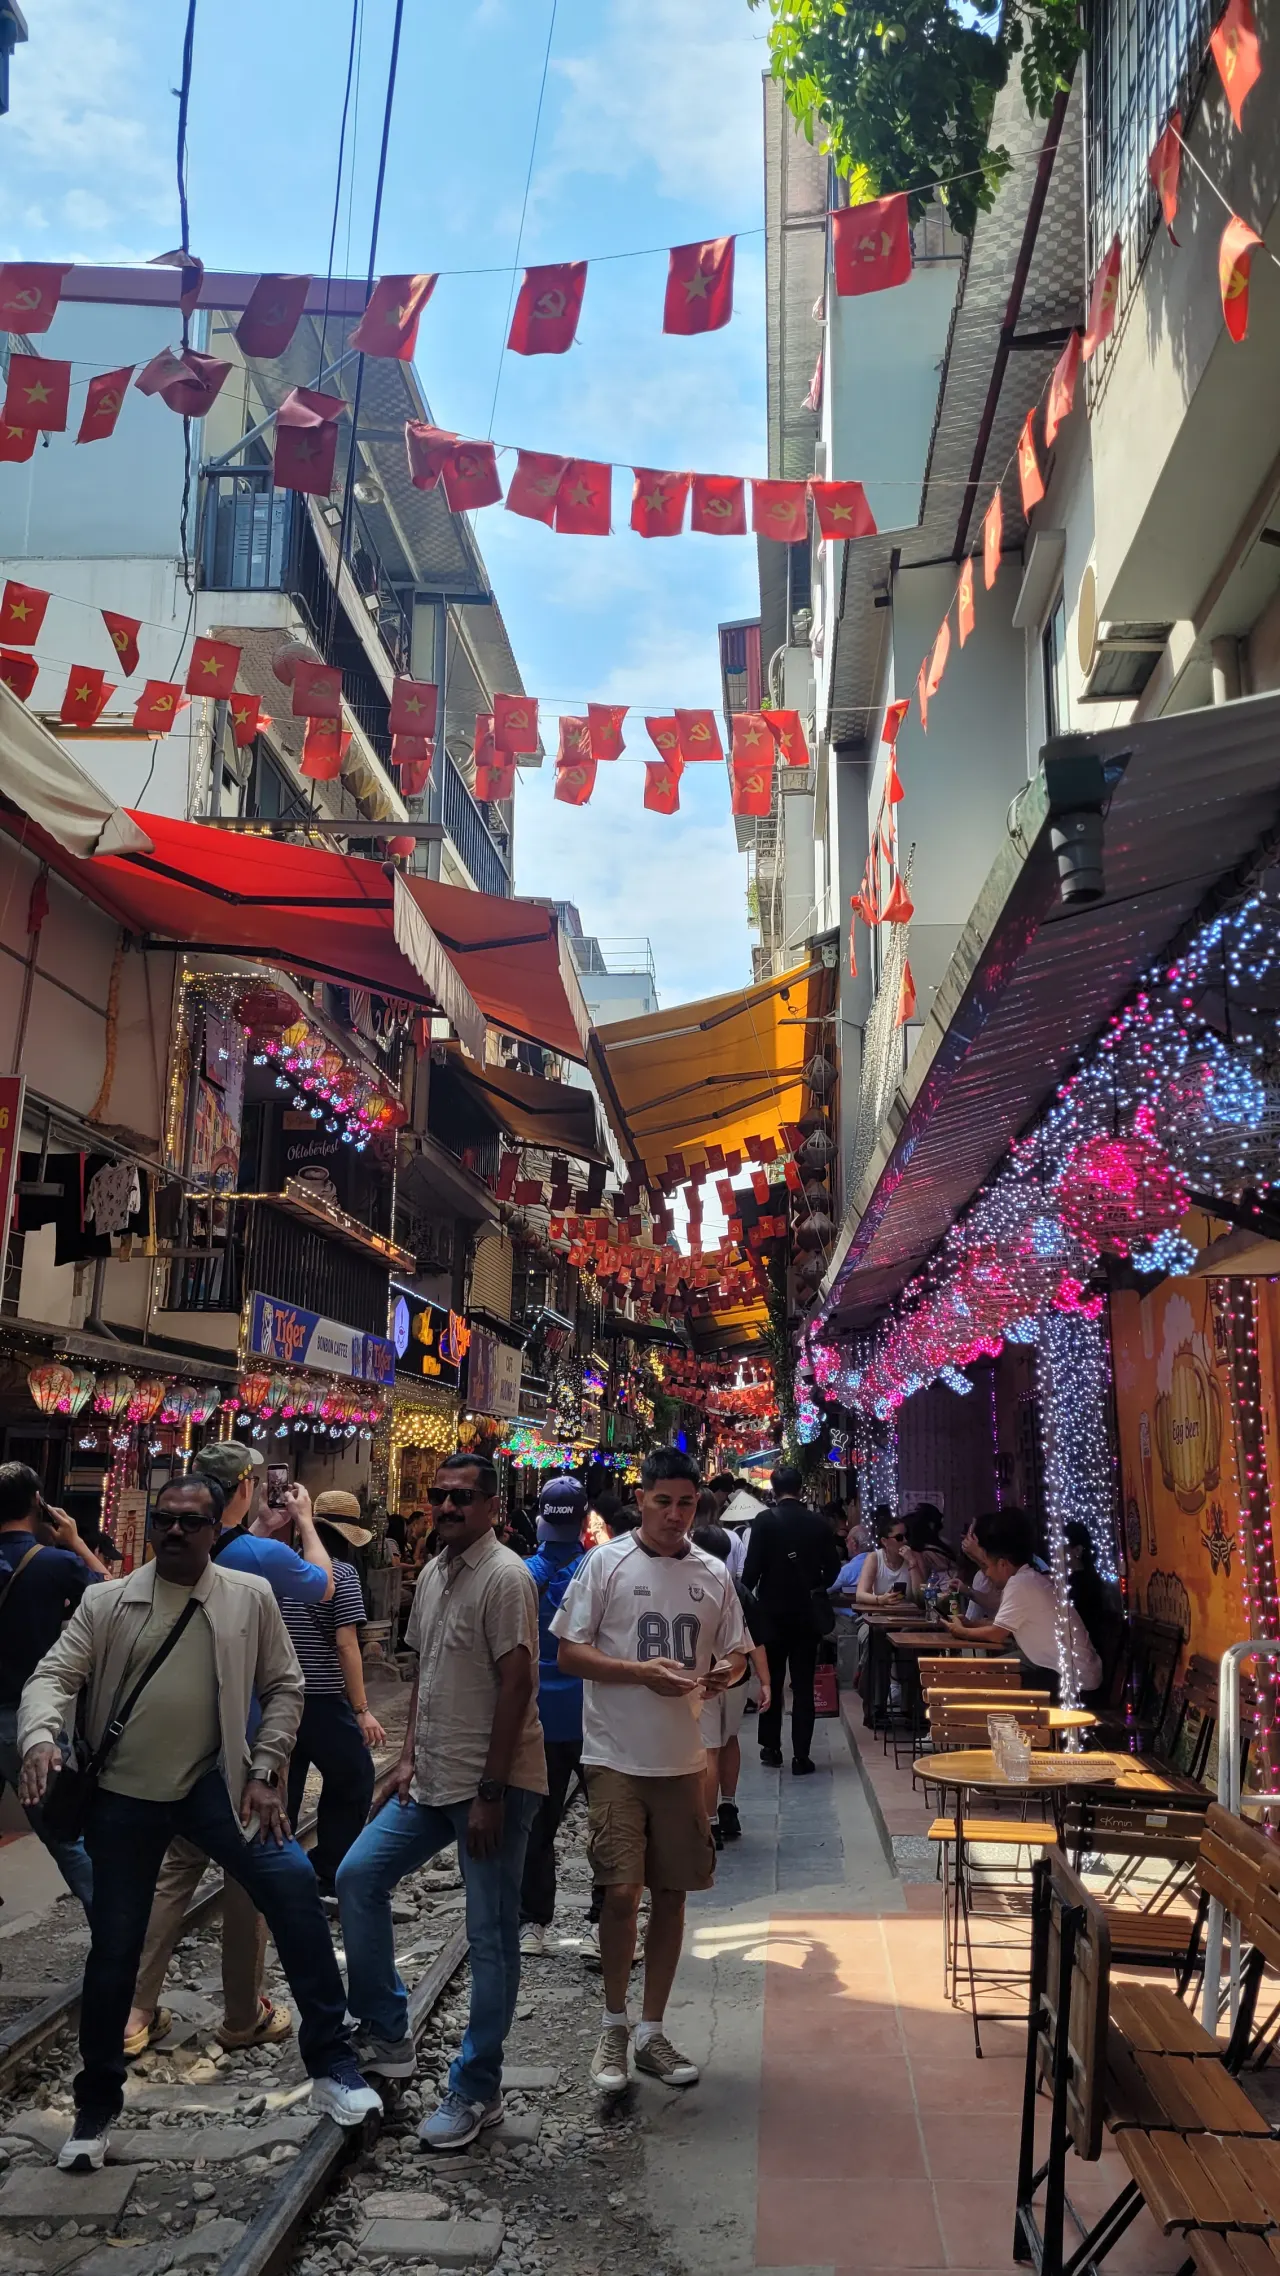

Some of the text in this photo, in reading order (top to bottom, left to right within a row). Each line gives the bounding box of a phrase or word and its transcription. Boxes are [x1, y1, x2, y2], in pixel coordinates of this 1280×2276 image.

[287, 1139, 340, 1160] Oktoberfest
[275, 1309, 306, 1360] Tiger
[317, 1335, 348, 1358] BONBON CAFFEE
[374, 1343, 392, 1380] Tiger
[1173, 1417, 1199, 1445] Egg Beer
[543, 1503, 574, 1515] SRIXON
[637, 1611, 701, 1670] 80
